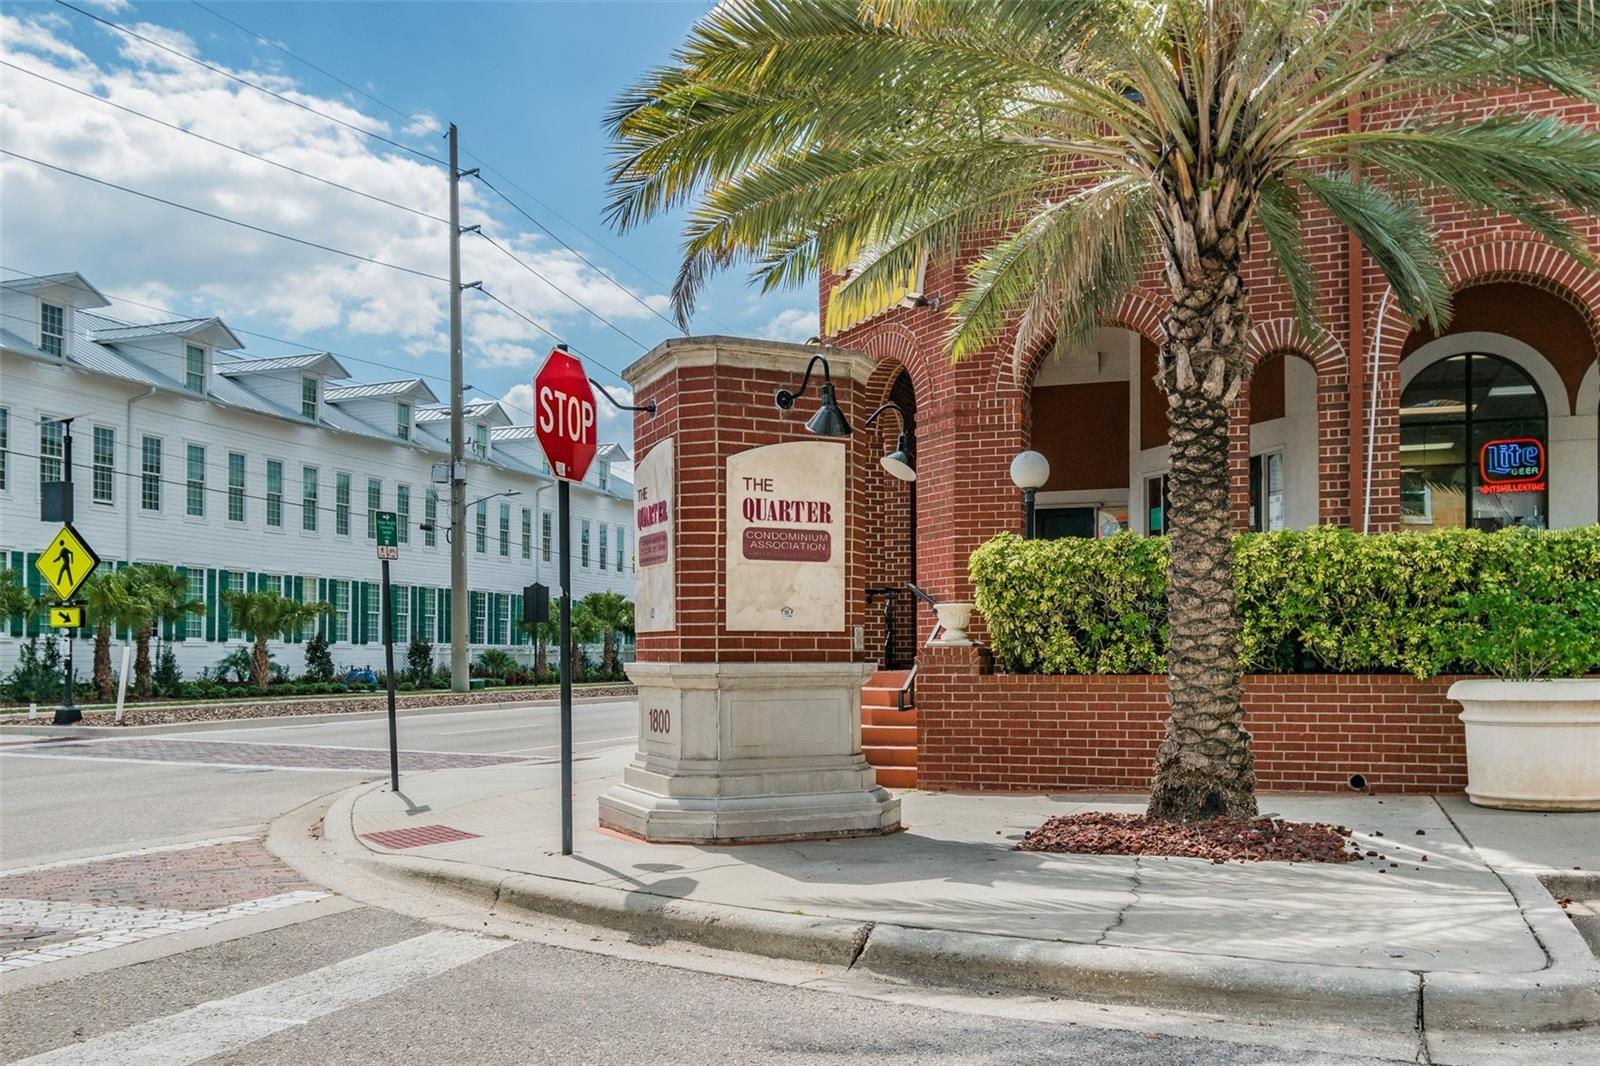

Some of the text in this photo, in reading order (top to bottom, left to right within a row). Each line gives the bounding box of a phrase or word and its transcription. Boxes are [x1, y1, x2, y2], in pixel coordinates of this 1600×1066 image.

[540, 386, 594, 445] STOP
[1488, 444, 1538, 474] Lite
[637, 486, 648, 502] THE
[742, 477, 774, 493] THE
[637, 500, 668, 531] QUARTER
[742, 497, 833, 524] QUARTER
[745, 530, 829, 542] CONDOMINIUM
[750, 540, 826, 551] ASSOCIATION
[649, 708, 671, 734] 1800
